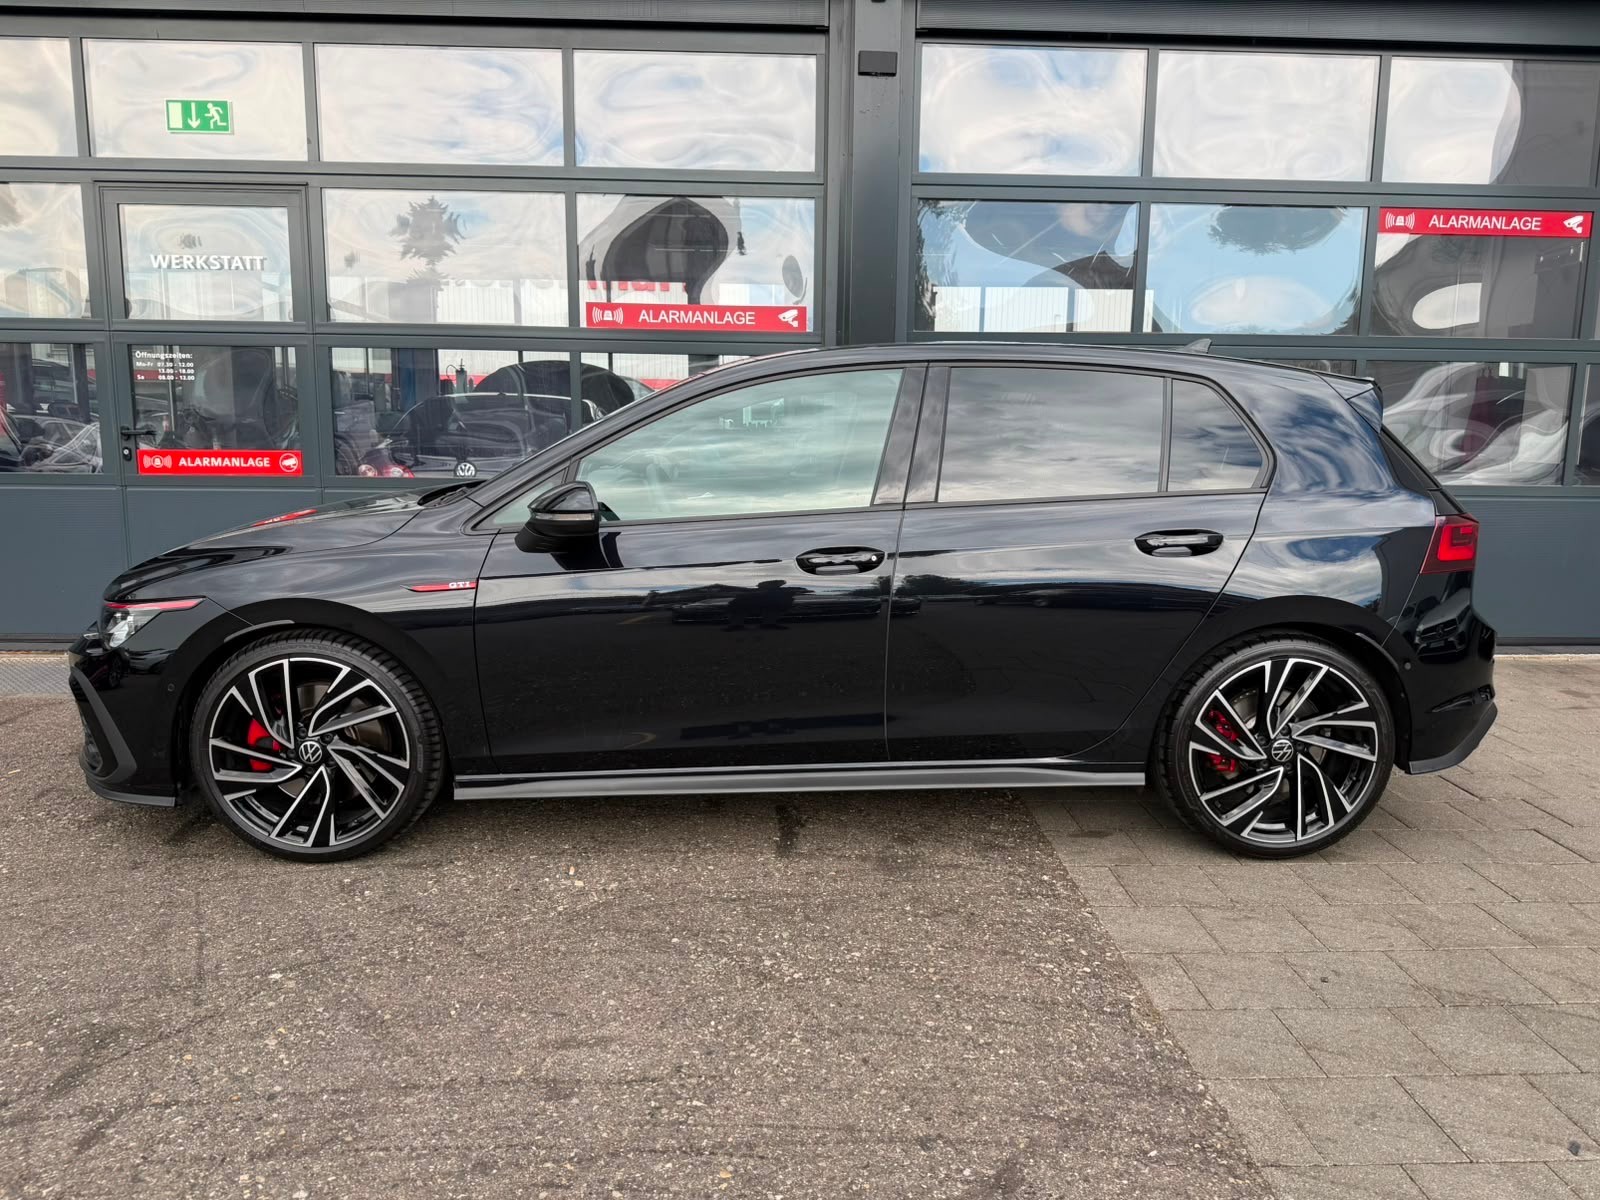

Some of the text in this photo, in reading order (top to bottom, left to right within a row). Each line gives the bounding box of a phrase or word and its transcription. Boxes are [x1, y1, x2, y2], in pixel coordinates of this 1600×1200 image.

[1428, 214, 1543, 231] ALARMANLAGE
[150, 254, 265, 270] WERKSTATT
[638, 309, 756, 325] ALARMANLAGE
[135, 350, 193, 360] Öffnungszeiten:
[178, 457, 271, 468] ALARMANLAGE
[448, 581, 471, 589] GTI
